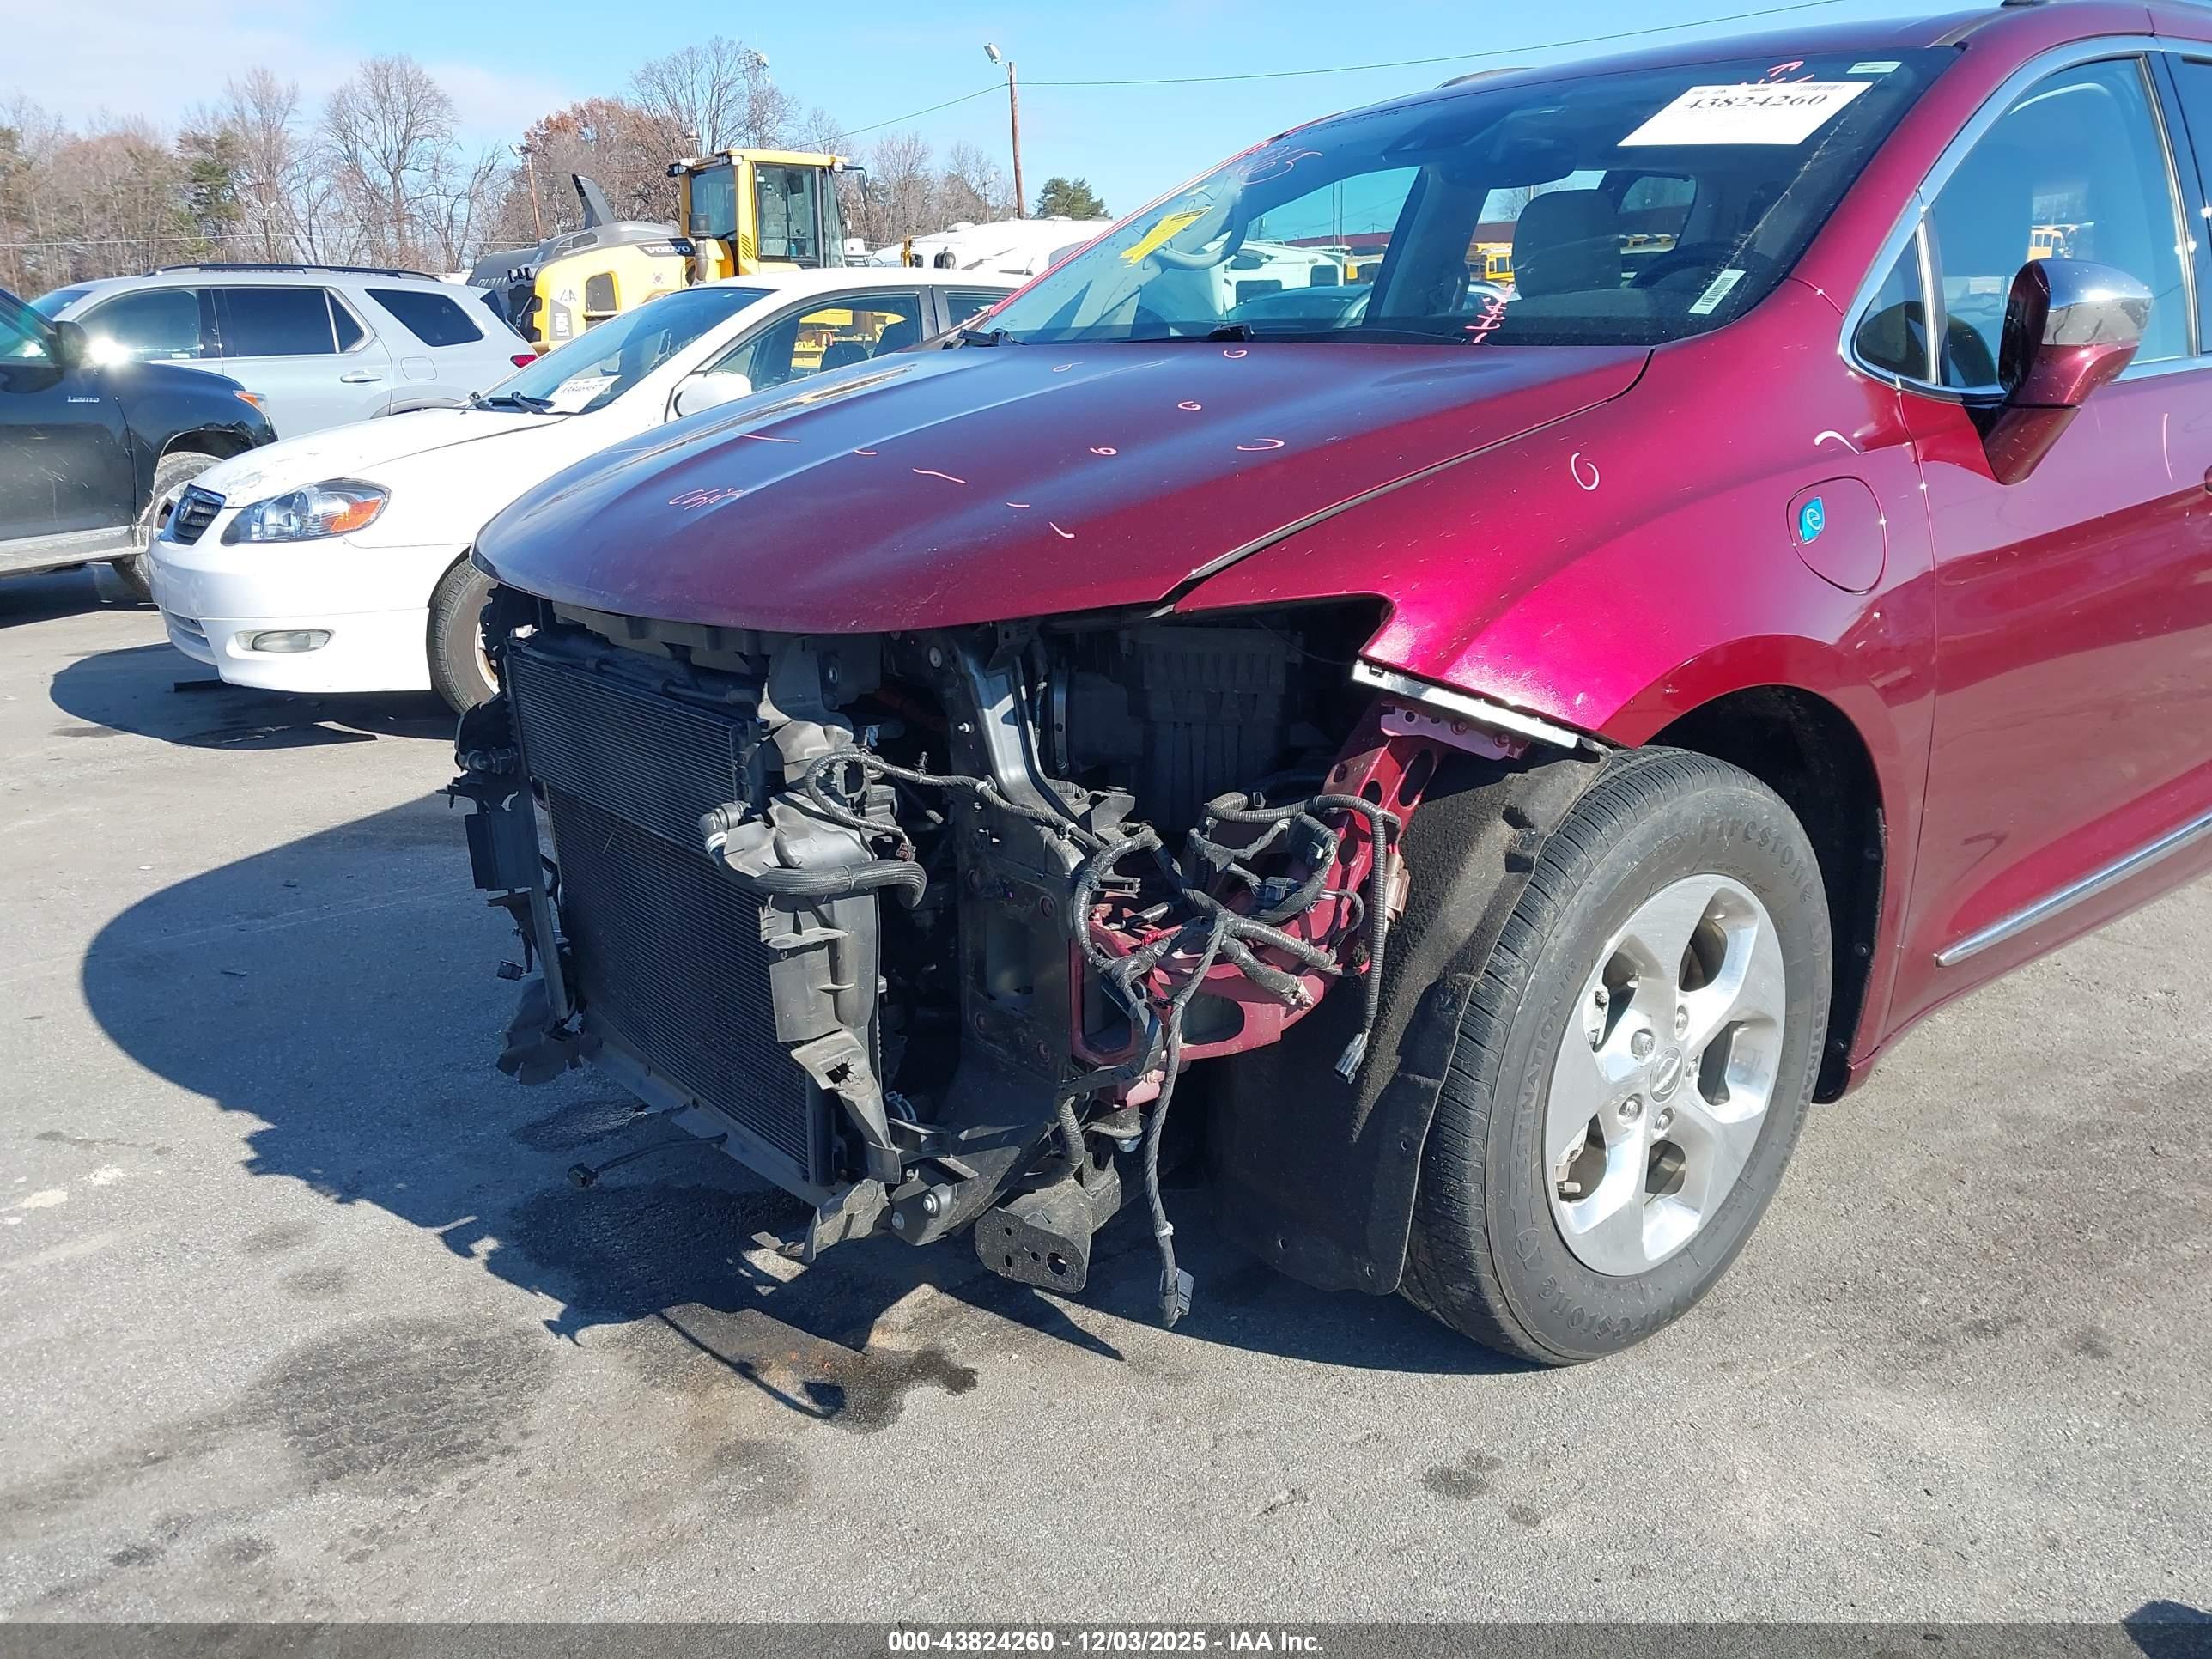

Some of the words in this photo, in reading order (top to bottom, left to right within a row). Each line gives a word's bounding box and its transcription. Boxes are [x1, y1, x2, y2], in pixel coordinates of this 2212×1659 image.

[1683, 94, 1828, 110] 43824260
[643, 246, 690, 254] VOLVO
[1697, 814, 1815, 905] Firestone
[1515, 996, 1562, 1197] DESTINATION
